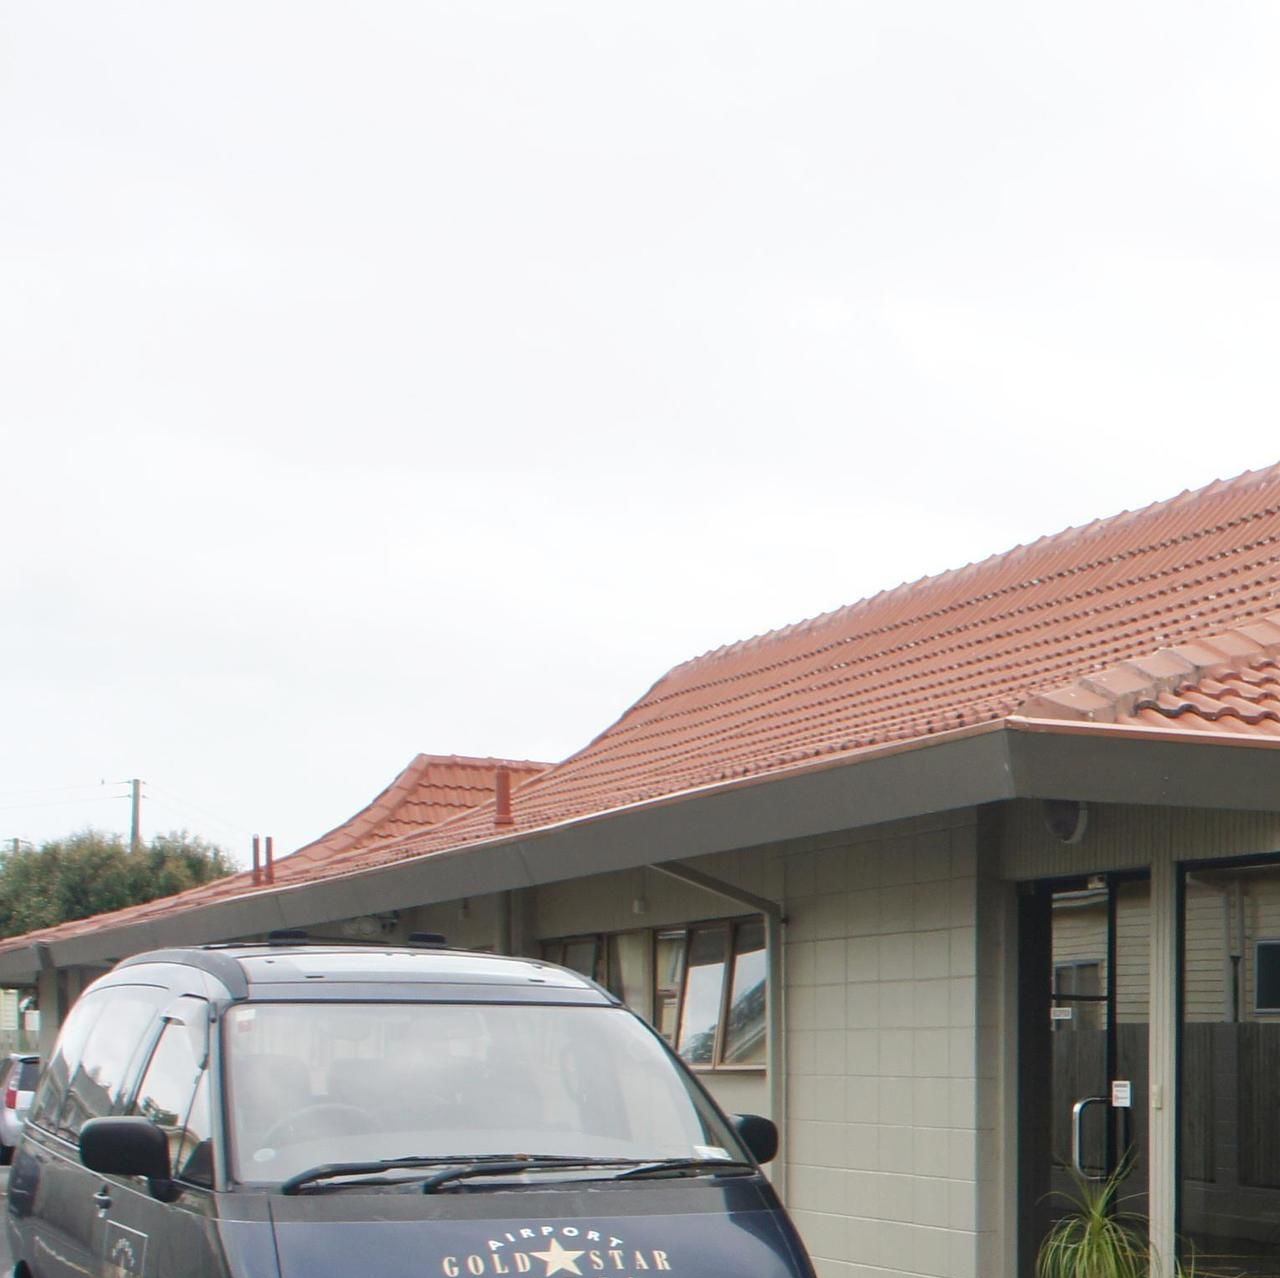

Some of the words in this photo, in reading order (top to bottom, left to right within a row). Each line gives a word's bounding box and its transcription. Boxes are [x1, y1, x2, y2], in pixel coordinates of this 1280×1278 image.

[488, 1225, 624, 1251] AIRPORT
[442, 1252, 532, 1278] GOLD
[589, 1249, 672, 1271] STAR
